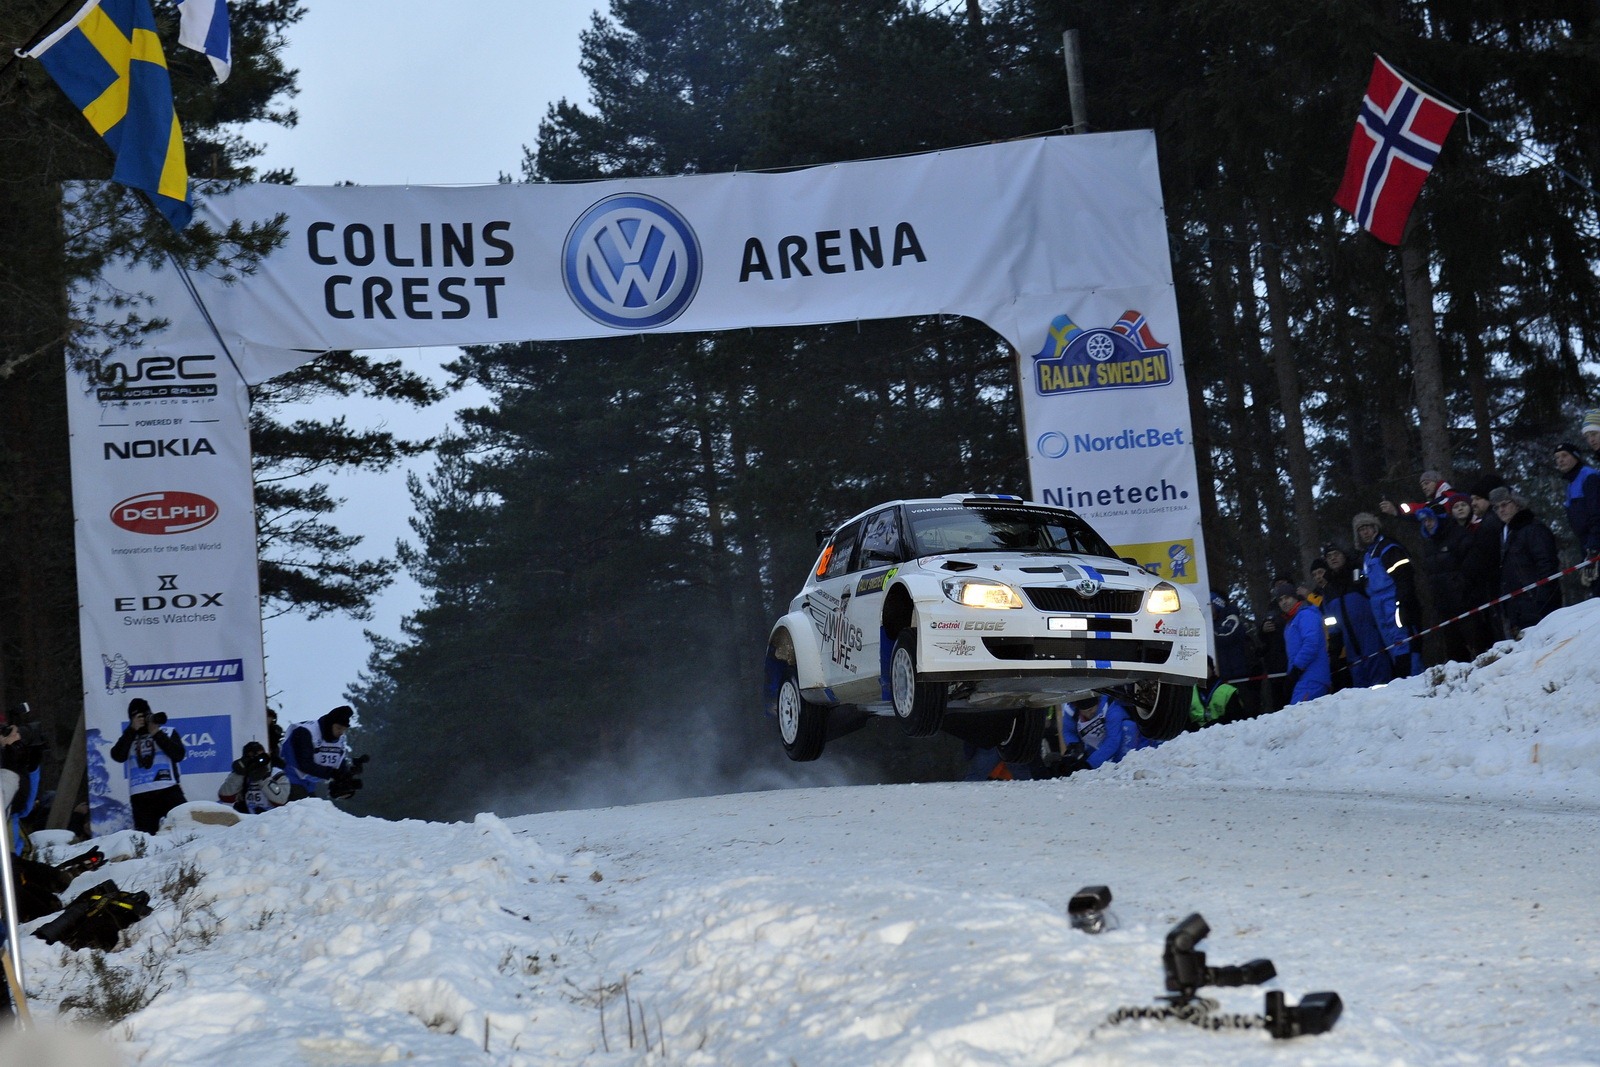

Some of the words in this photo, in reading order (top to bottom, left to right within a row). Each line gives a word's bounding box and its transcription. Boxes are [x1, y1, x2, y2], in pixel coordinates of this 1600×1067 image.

[307, 220, 514, 267] COLINS
[739, 221, 927, 282] ARENA
[324, 275, 506, 319] CREST
[1040, 364, 1091, 391] RALLY
[1096, 354, 1167, 386] SWEDEN
[123, 388, 168, 397] WORLD
[170, 387, 215, 395] RALLY
[100, 398, 215, 408] CHMPIONSHIP
[135, 418, 171, 427] POWERED
[1074, 428, 1184, 453] NordicBet
[104, 438, 217, 460] NOKIA
[1043, 479, 1189, 508] Ninetech.
[123, 505, 206, 521] DELPHI
[911, 506, 964, 514] VOLKSWAGEN
[111, 547, 152, 555] Innovation
[166, 544, 179, 552] the
[180, 544, 197, 552] Real
[114, 592, 224, 612] EDOX
[123, 616, 160, 626] Swiss
[162, 613, 216, 624] Watches
[937, 621, 961, 629] Castrol
[964, 621, 1007, 631] EDGE
[133, 663, 239, 682] MICHELIN
[180, 732, 215, 747] KIA
[188, 748, 217, 759] People
[320, 754, 338, 764] 315
